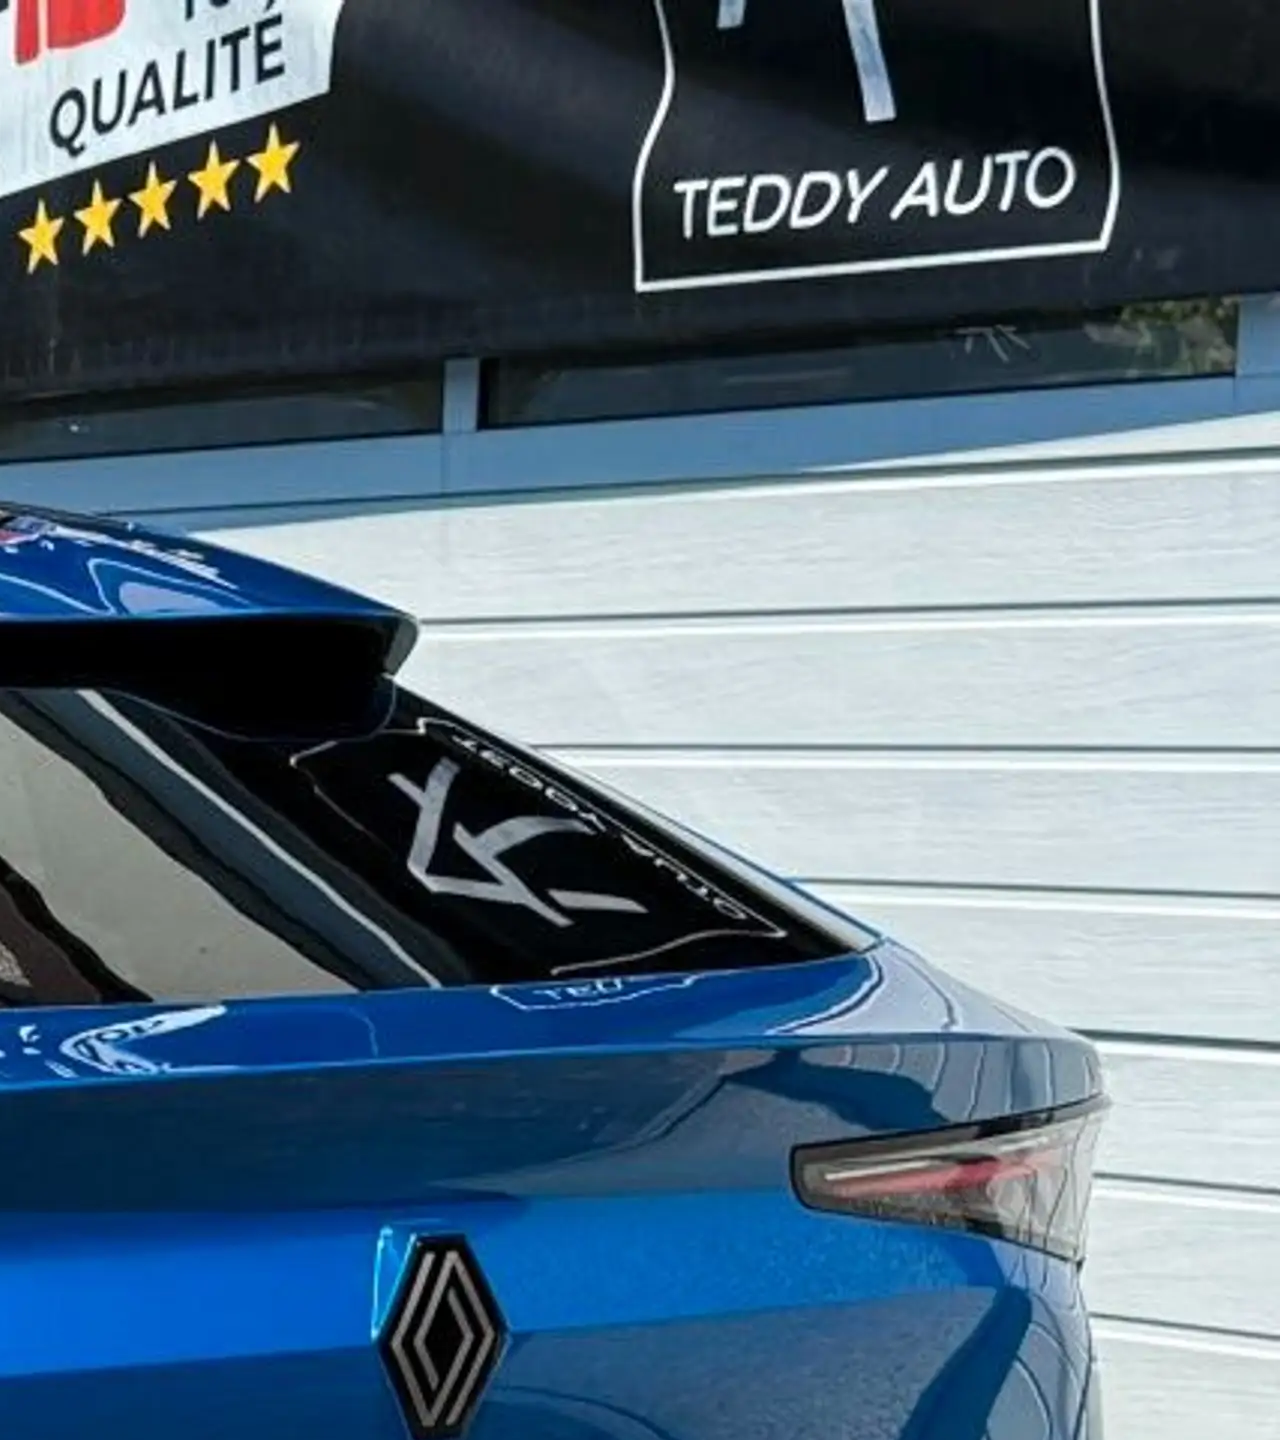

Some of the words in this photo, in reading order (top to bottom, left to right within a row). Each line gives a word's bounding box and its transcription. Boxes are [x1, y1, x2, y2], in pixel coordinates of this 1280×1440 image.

[48, 0, 286, 158] QUALITÉ
[674, 167, 888, 239] TEDDY
[890, 146, 1077, 220] AUTO
